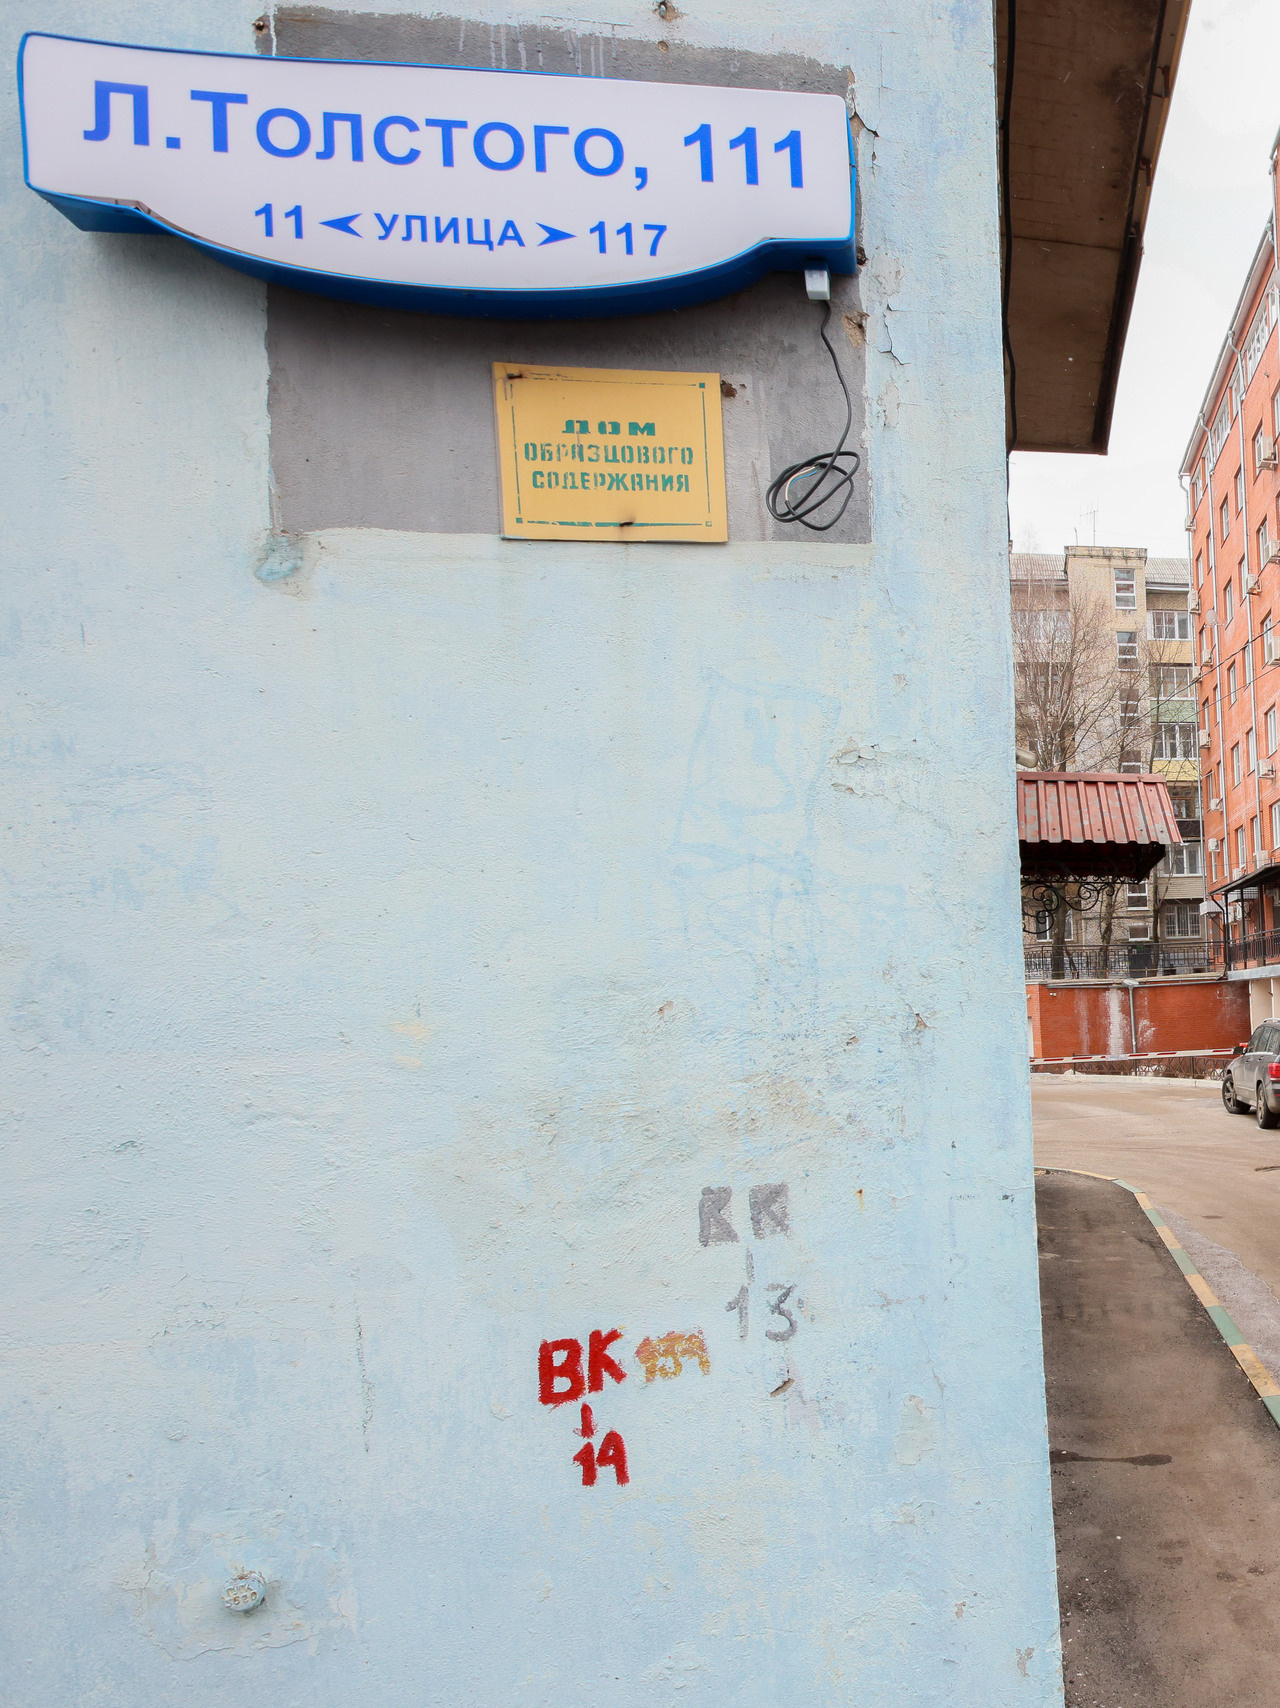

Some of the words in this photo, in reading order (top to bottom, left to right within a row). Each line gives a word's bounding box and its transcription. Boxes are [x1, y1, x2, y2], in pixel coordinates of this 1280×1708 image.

[683, 122, 804, 189] 111
[253, 201, 304, 240] 11
[373, 211, 526, 252] УЛИЦА
[589, 220, 668, 257] 117
[561, 419, 656, 437] ДОМ
[524, 442, 694, 466] ОБРАЗЦОВОГО
[531, 470, 690, 492] СОДЕРЖАНИЯ
[725, 1281, 798, 1342] 13
